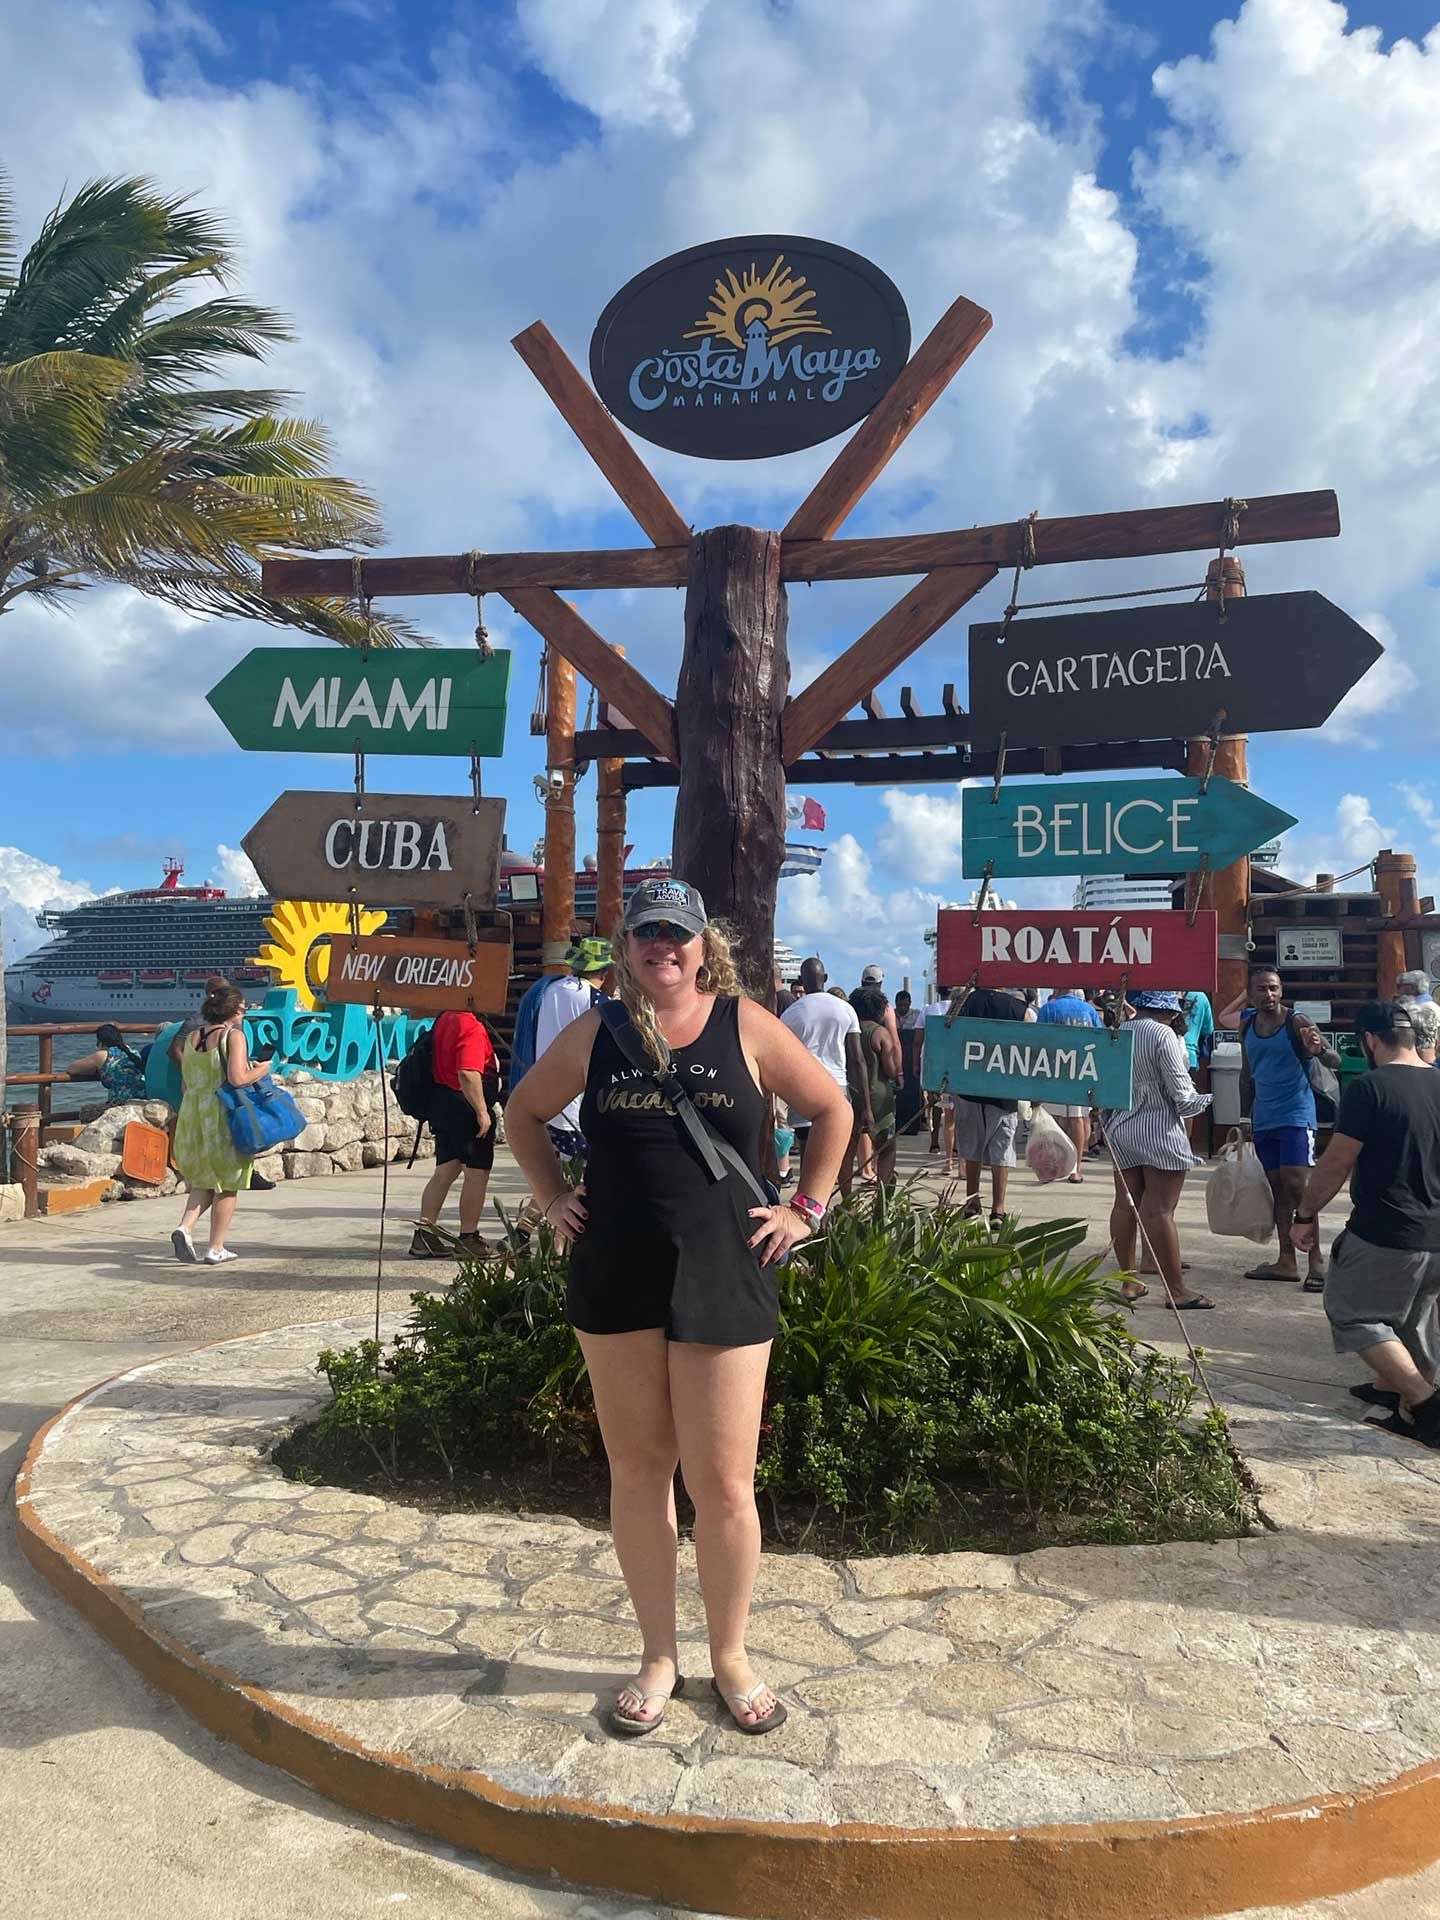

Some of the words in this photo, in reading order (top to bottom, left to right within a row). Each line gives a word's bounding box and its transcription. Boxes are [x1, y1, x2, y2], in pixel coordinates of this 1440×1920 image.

[629, 337, 743, 411] Costa
[764, 344, 881, 402] Maya
[673, 388, 816, 407] MAHAHUAL
[1007, 642, 1232, 696] CARTAGENA
[273, 677, 452, 731] MIAMI
[325, 819, 453, 871] CUBA
[1012, 799, 1199, 857] BELICE
[981, 916, 1153, 964] ROATÁN
[341, 953, 387, 982] NEW
[394, 956, 476, 988] ORLEANS
[611, 1063, 678, 1084] ALWS
[690, 1064, 718, 1079] ON
[964, 1041, 1099, 1081] PANAMÁ
[597, 1087, 734, 1116] Vacaon
